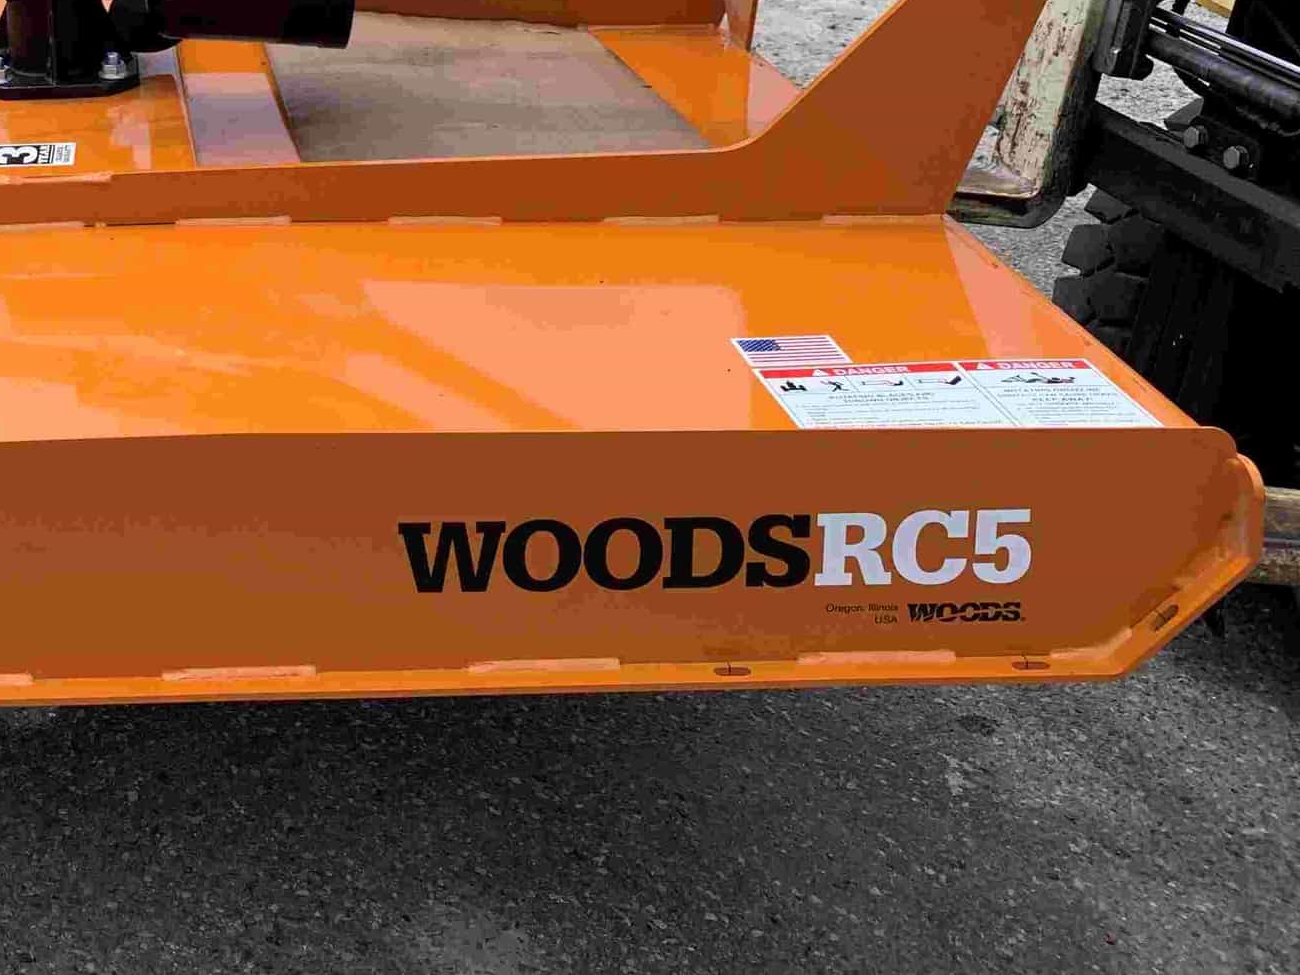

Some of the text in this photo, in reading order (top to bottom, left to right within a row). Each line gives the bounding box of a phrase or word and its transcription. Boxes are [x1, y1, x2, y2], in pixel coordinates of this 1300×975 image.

[832, 365, 911, 376] DANGER
[999, 360, 1076, 370] DANGER
[867, 601, 899, 612] Illinois
[874, 614, 898, 625] USA
